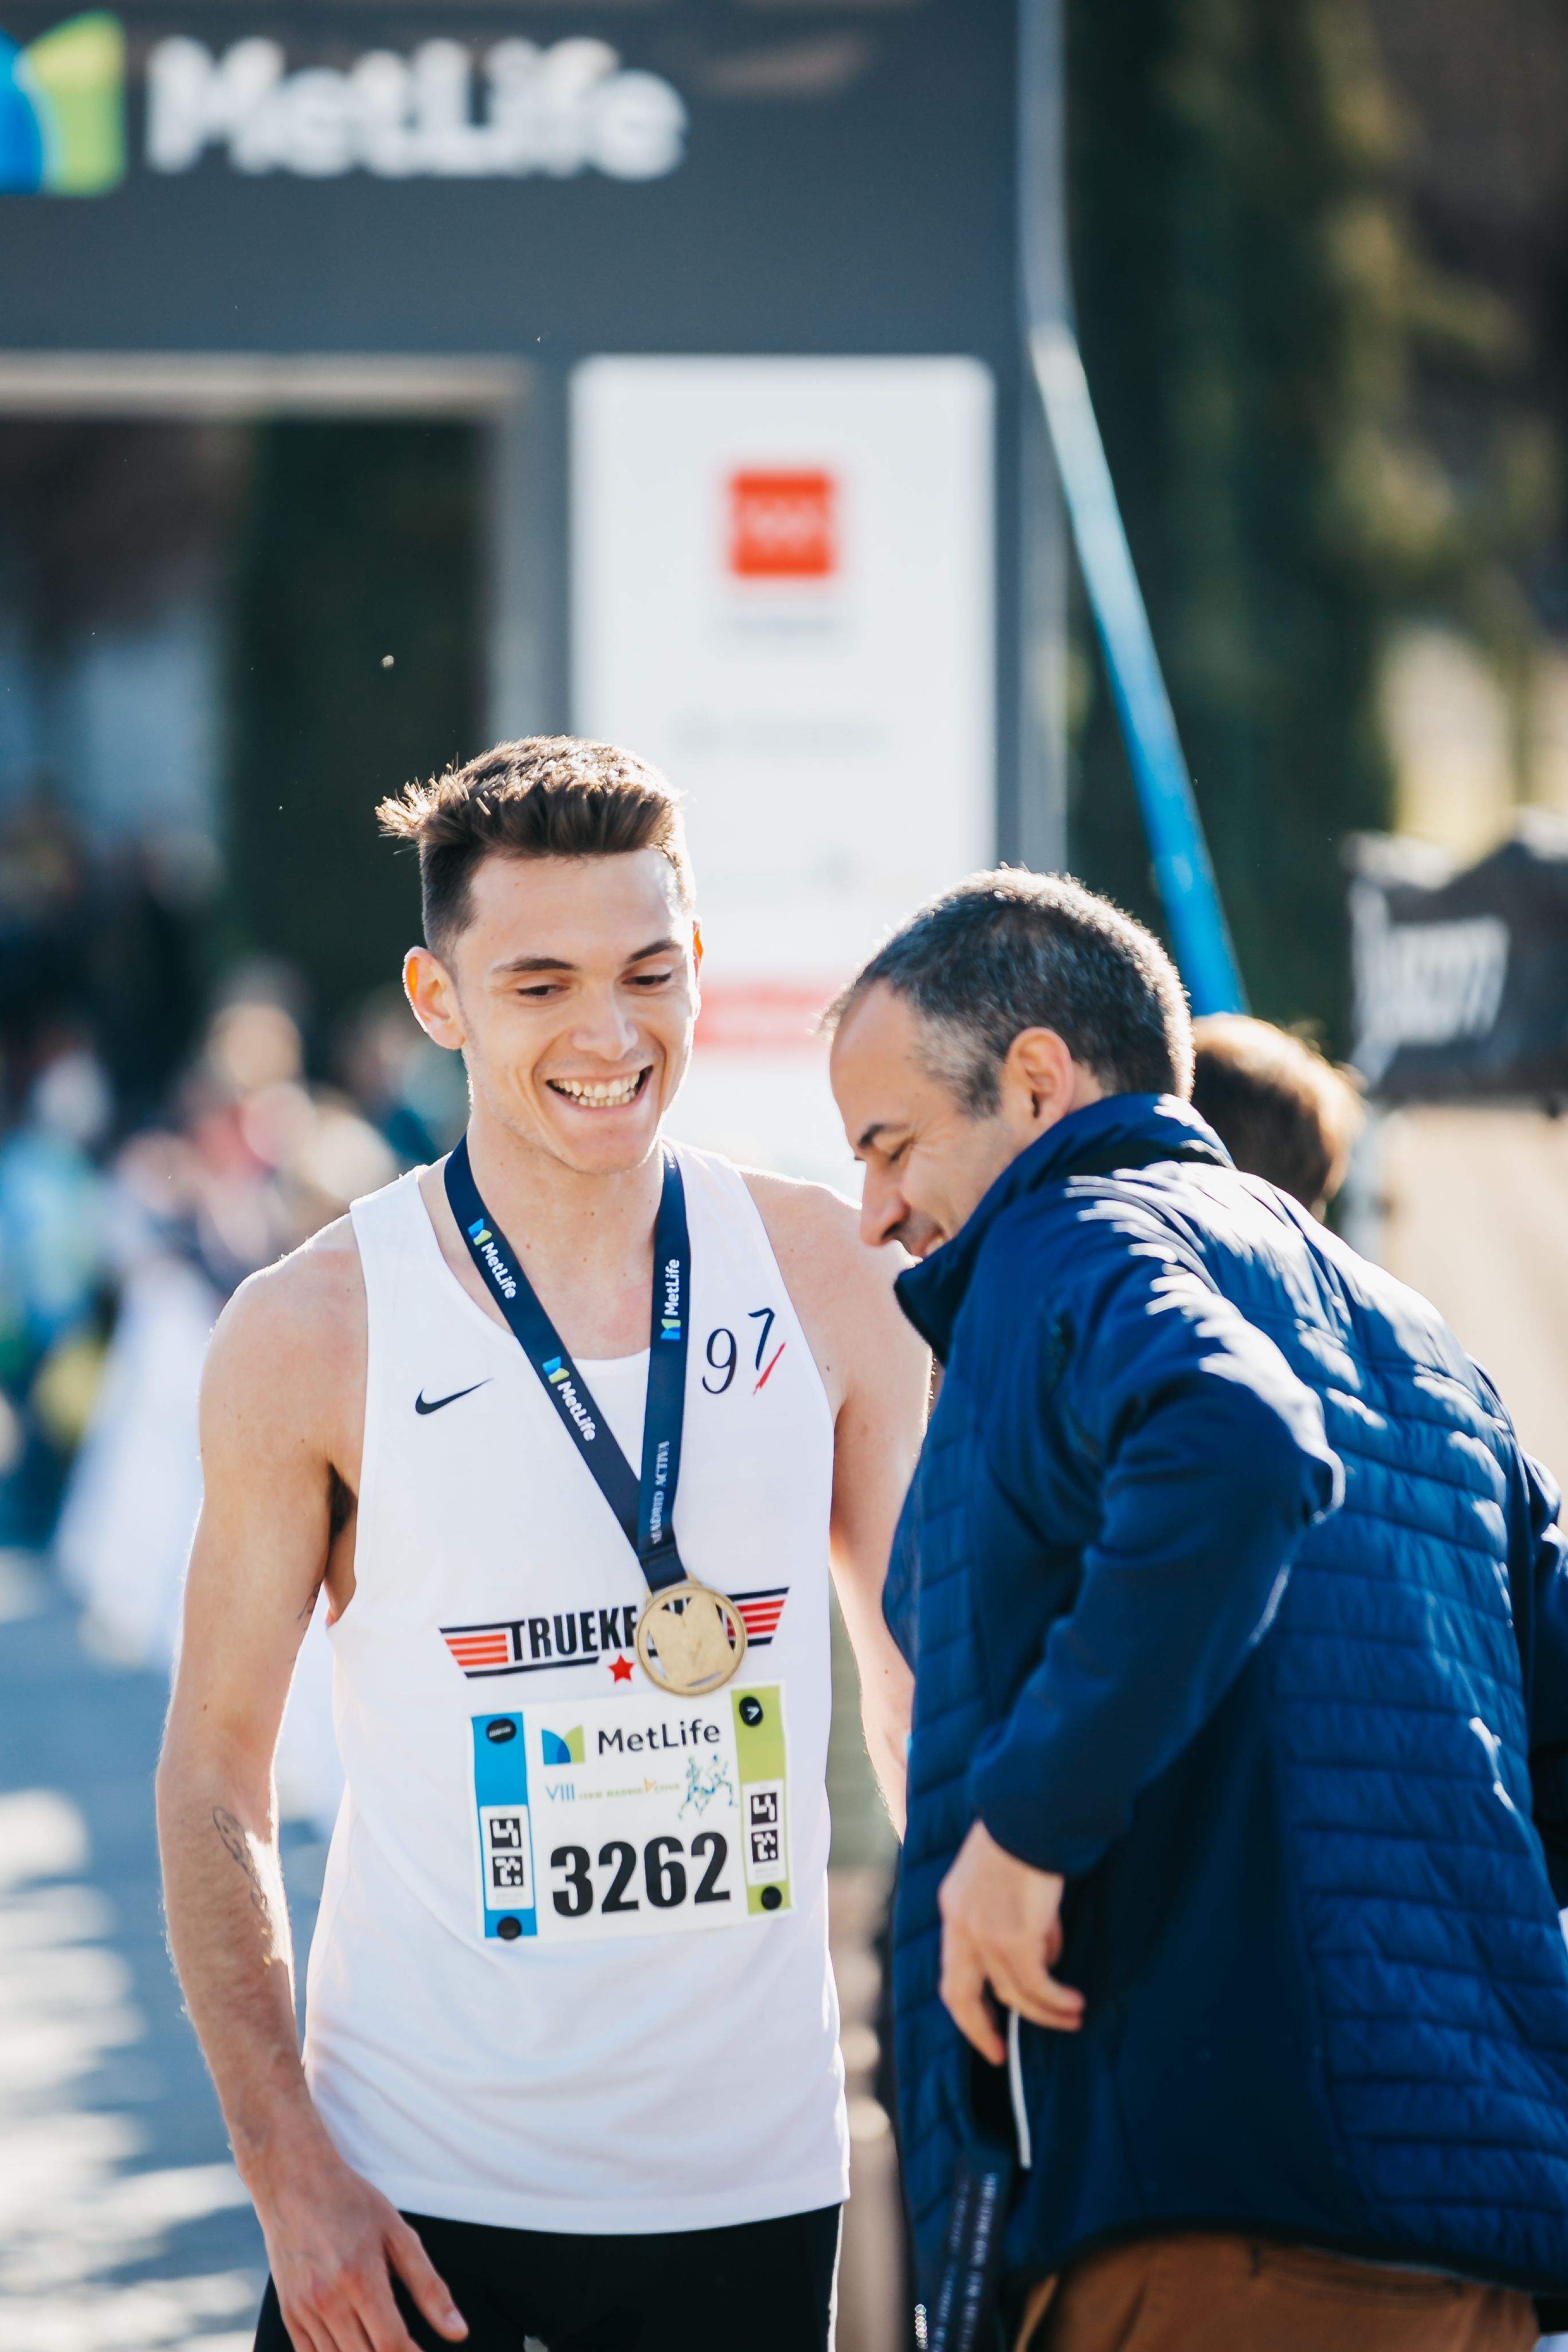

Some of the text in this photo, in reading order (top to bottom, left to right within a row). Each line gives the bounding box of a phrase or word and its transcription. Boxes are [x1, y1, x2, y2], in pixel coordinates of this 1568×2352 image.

[146, 36, 687, 181] MetLife
[481, 1242, 516, 1299] MetLife
[664, 1259, 680, 1316] MetLife
[558, 1381, 595, 1441] MetLife
[598, 1719, 720, 1755] MetLife
[545, 1783, 575, 1802] VIII
[550, 1832, 731, 1918] 3262
